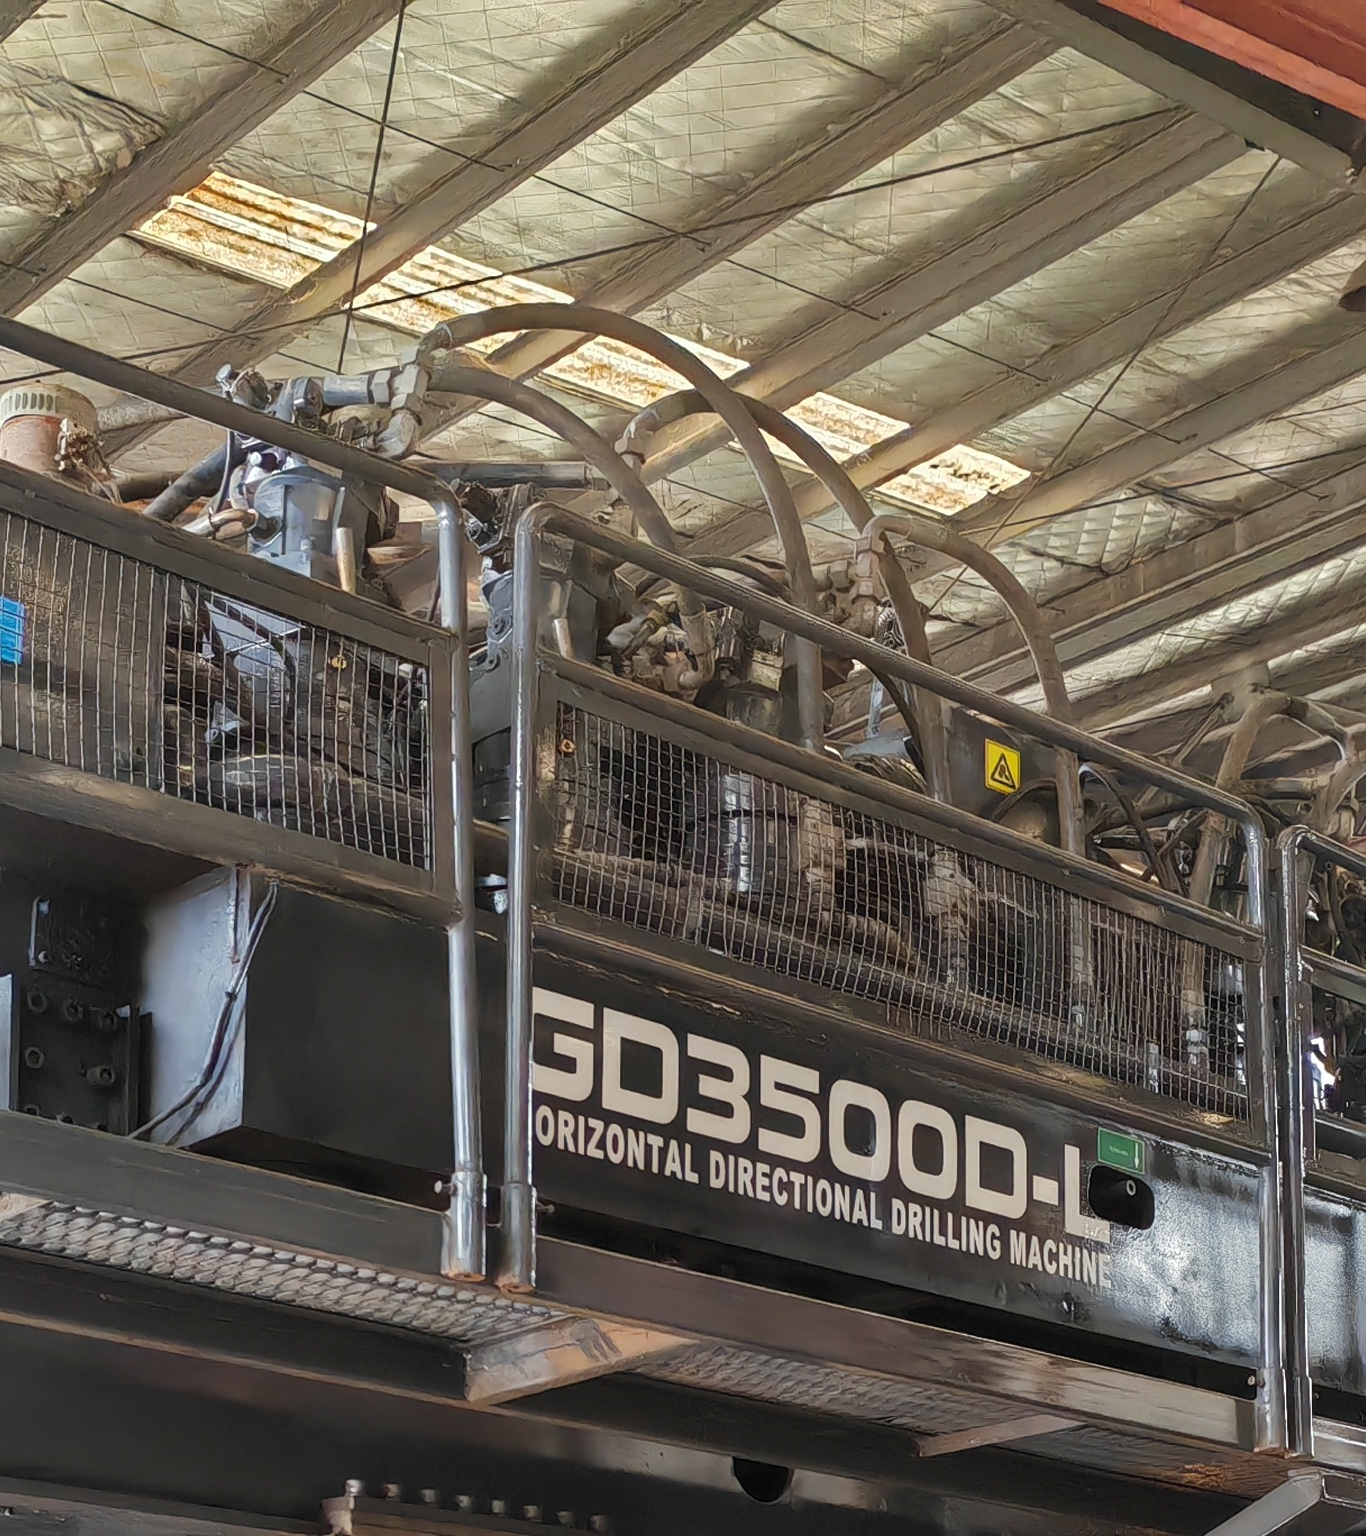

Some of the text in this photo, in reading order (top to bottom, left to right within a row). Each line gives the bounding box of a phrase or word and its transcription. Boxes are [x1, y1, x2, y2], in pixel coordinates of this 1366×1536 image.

[531, 985, 1112, 1244] GD3500D-L
[534, 1104, 1112, 1289] ORIZONTAL DIRECTIONAL DRILLING MACHINE
